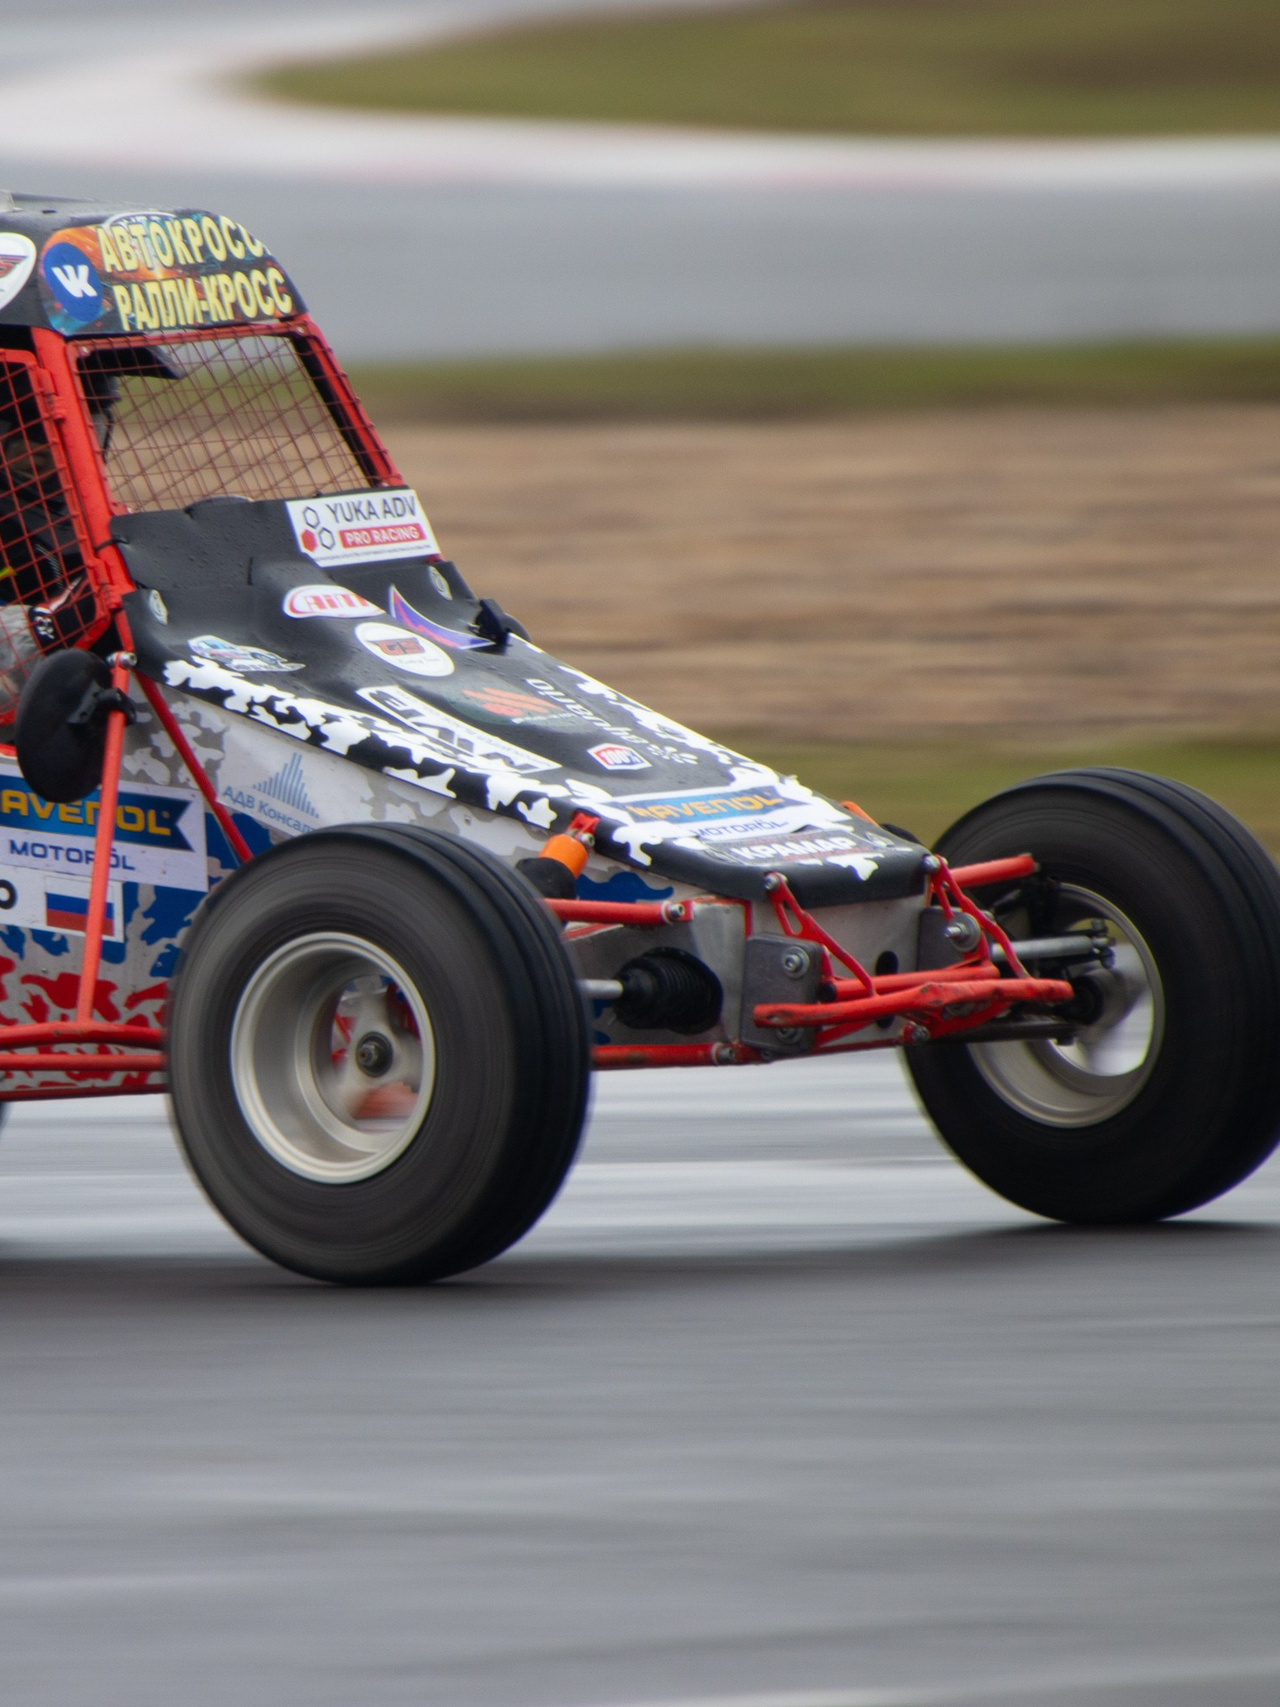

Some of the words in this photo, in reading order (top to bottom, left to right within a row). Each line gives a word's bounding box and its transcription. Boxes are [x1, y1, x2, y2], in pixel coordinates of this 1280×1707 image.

[113, 267, 293, 332] РАЛЛИ-КРОСС
[325, 499, 380, 524] YUKA
[383, 495, 417, 519] ADV
[344, 531, 372, 546] PRO
[373, 526, 421, 544] RACING
[222, 785, 256, 809] АДВ
